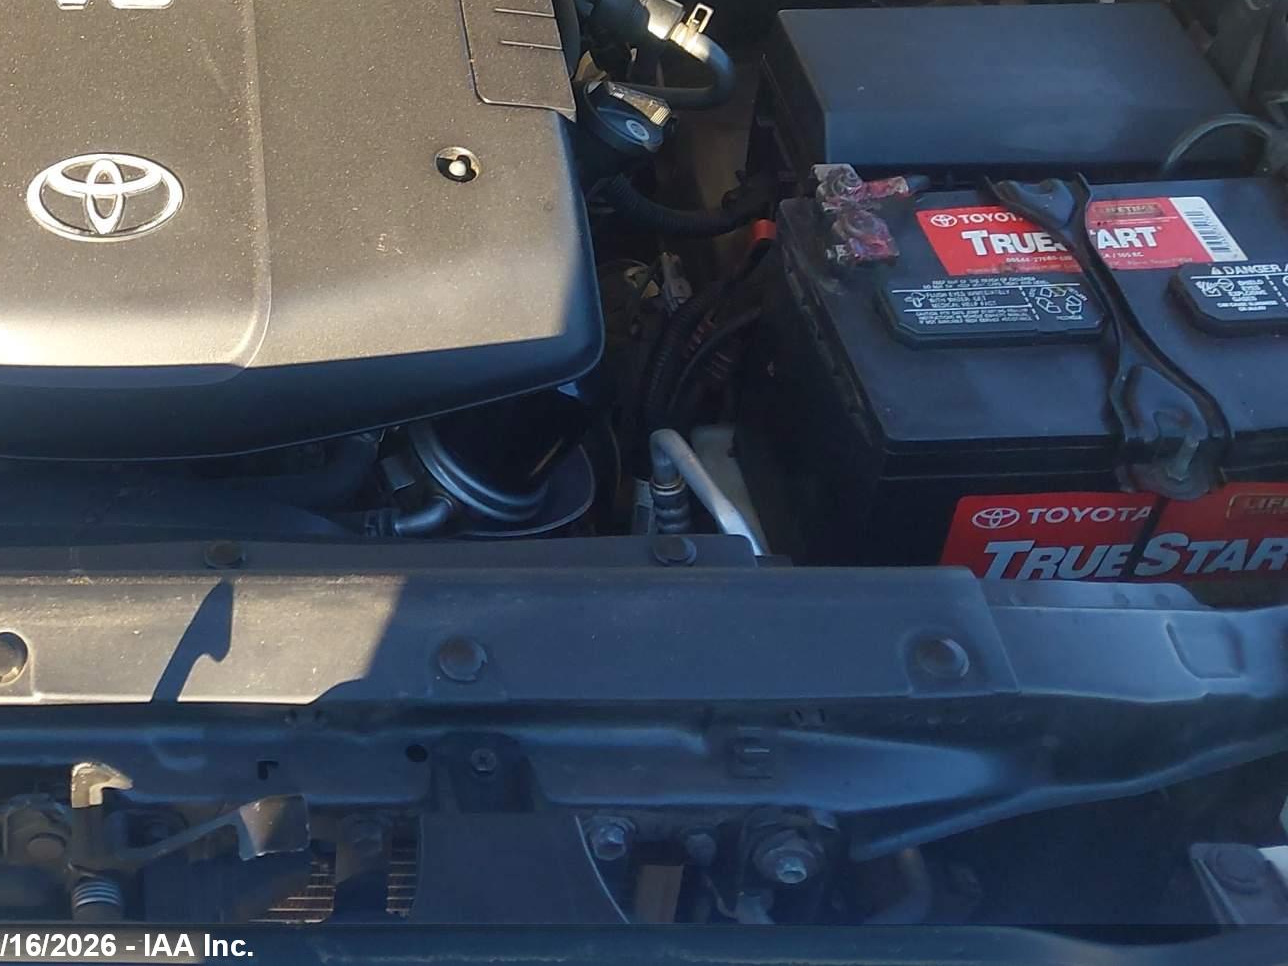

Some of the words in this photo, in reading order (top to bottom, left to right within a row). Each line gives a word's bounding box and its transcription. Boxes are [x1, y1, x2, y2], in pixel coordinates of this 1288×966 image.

[957, 211, 1024, 225] TOYOT
[1222, 263, 1282, 275] DANGER
[1027, 505, 1153, 525] TOYOTA
